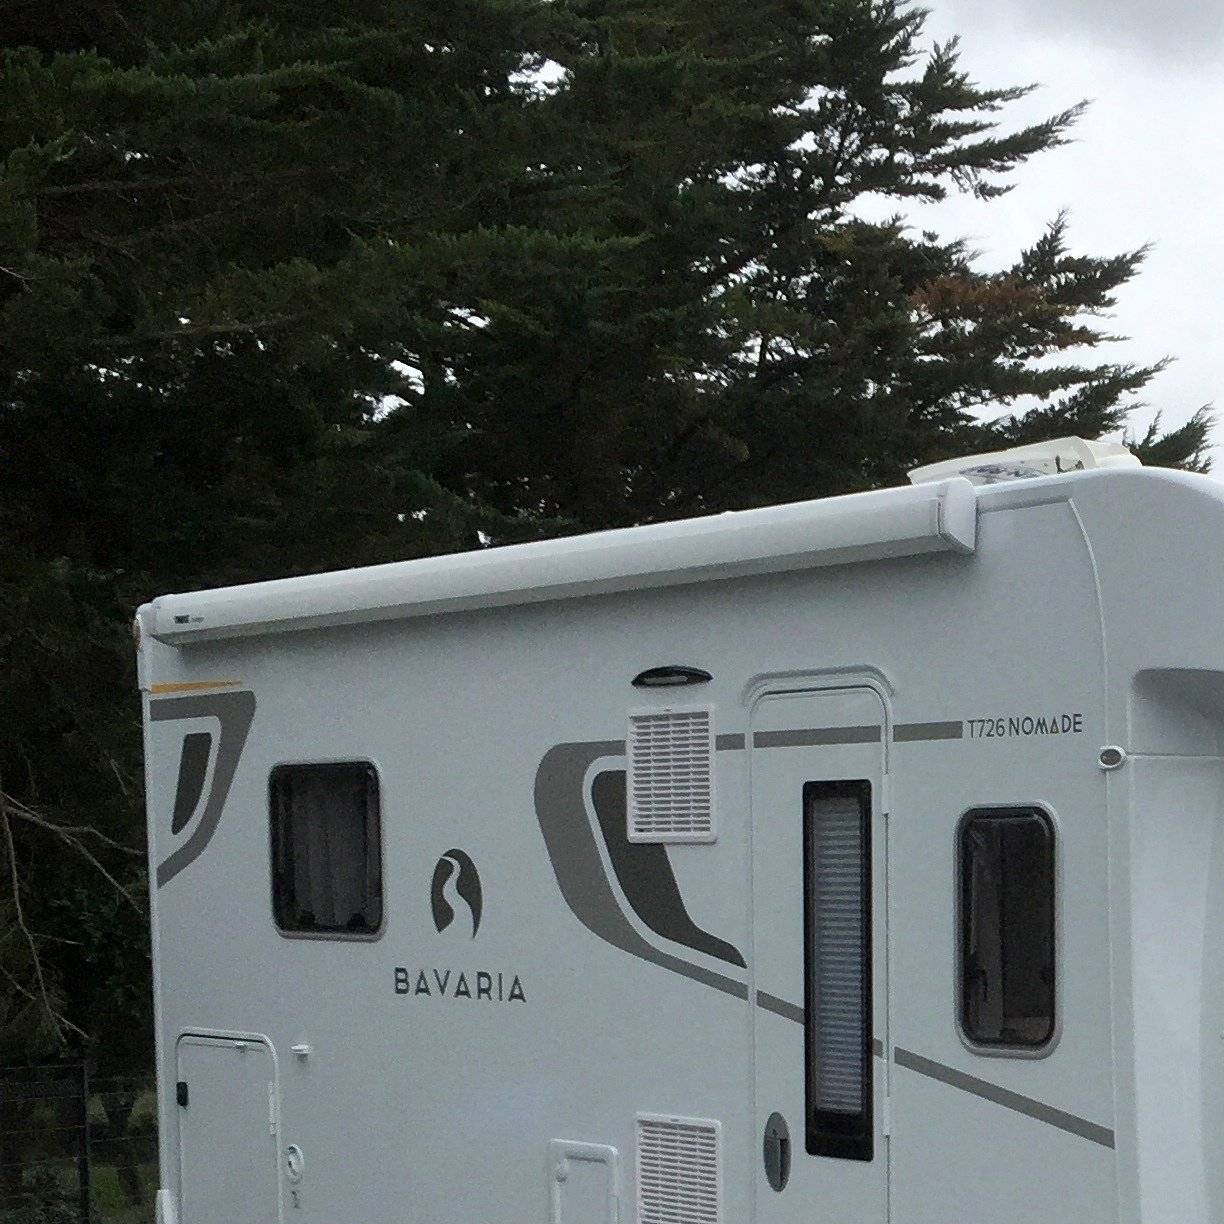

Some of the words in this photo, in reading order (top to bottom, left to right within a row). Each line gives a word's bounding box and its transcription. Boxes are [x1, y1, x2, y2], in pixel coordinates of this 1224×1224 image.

[967, 718, 1006, 738] T726
[1008, 713, 1083, 737] NOMADE
[394, 966, 527, 1003] BAVARIA
